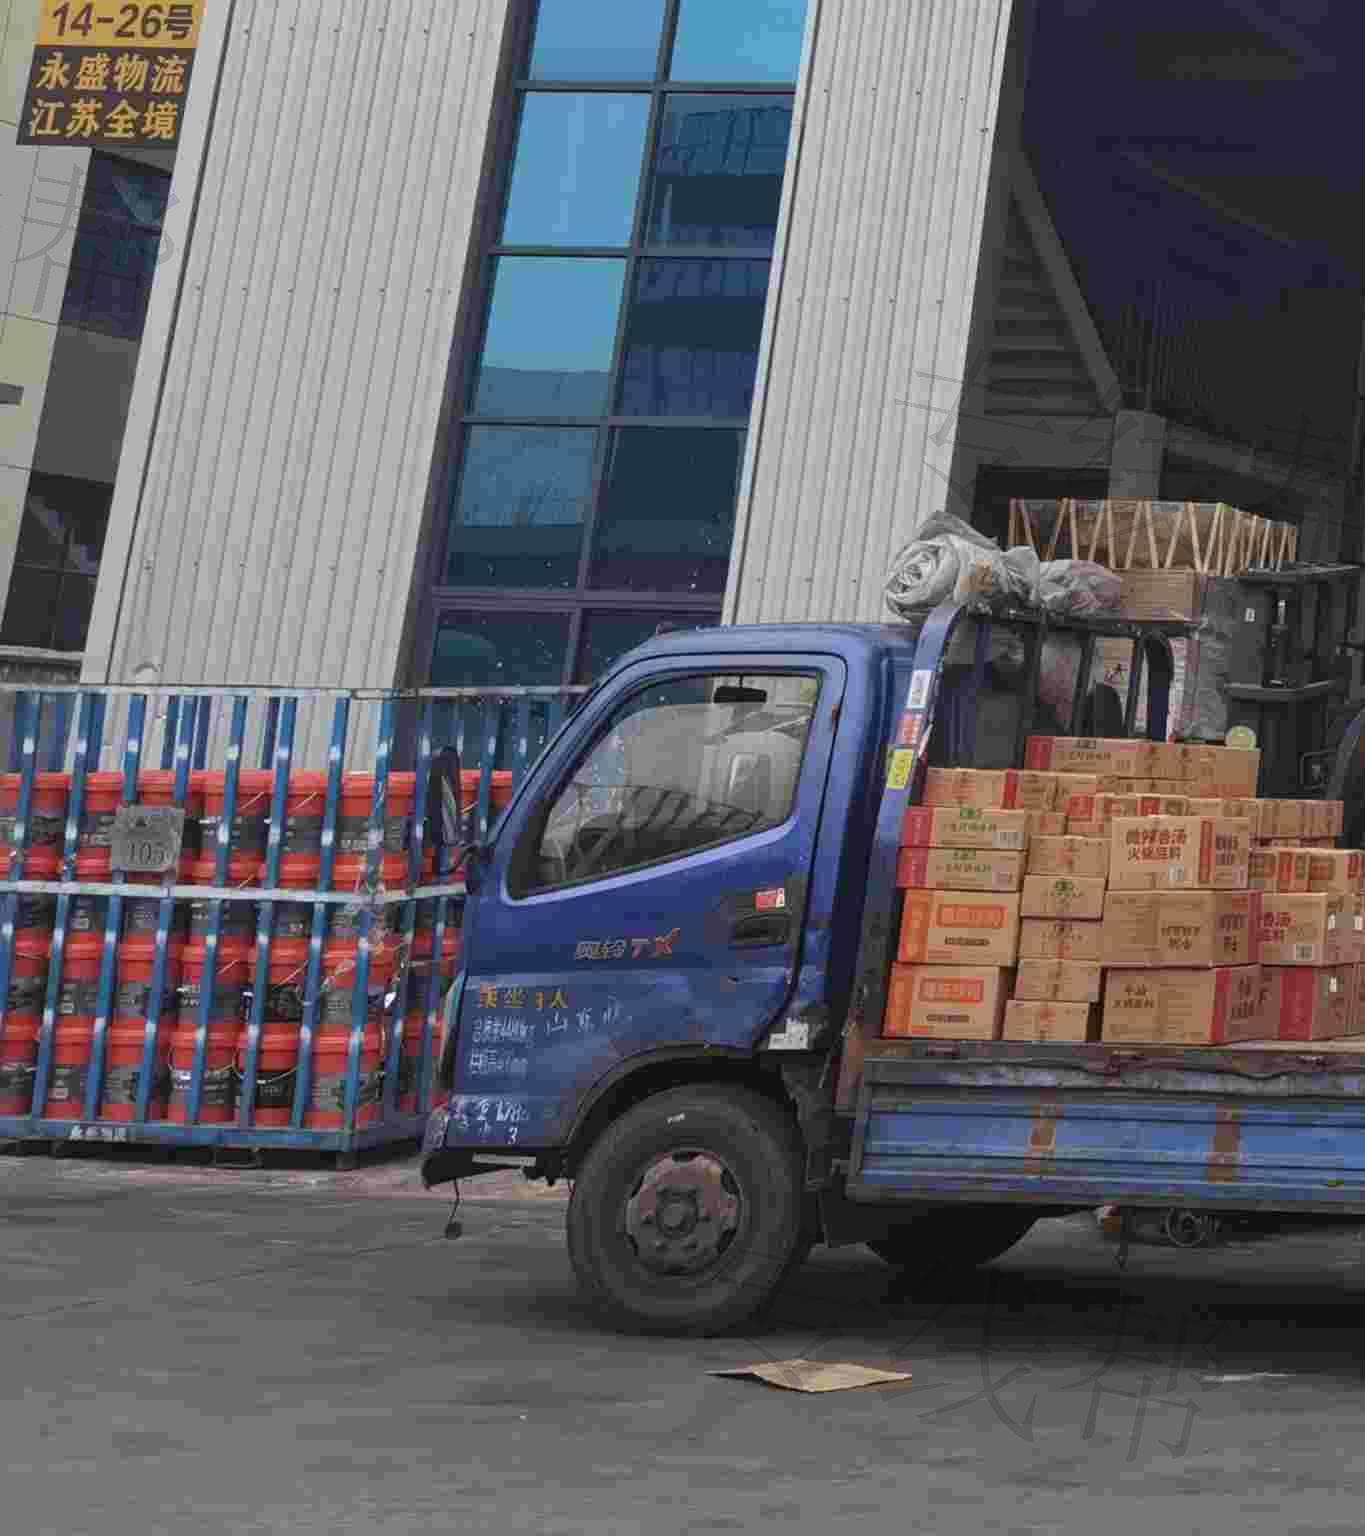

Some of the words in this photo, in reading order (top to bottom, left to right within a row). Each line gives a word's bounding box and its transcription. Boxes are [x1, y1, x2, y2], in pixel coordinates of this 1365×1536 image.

[53, 2, 194, 41] 14-26号
[36, 52, 189, 97] 永盛物流
[30, 99, 179, 140] 江苏全境
